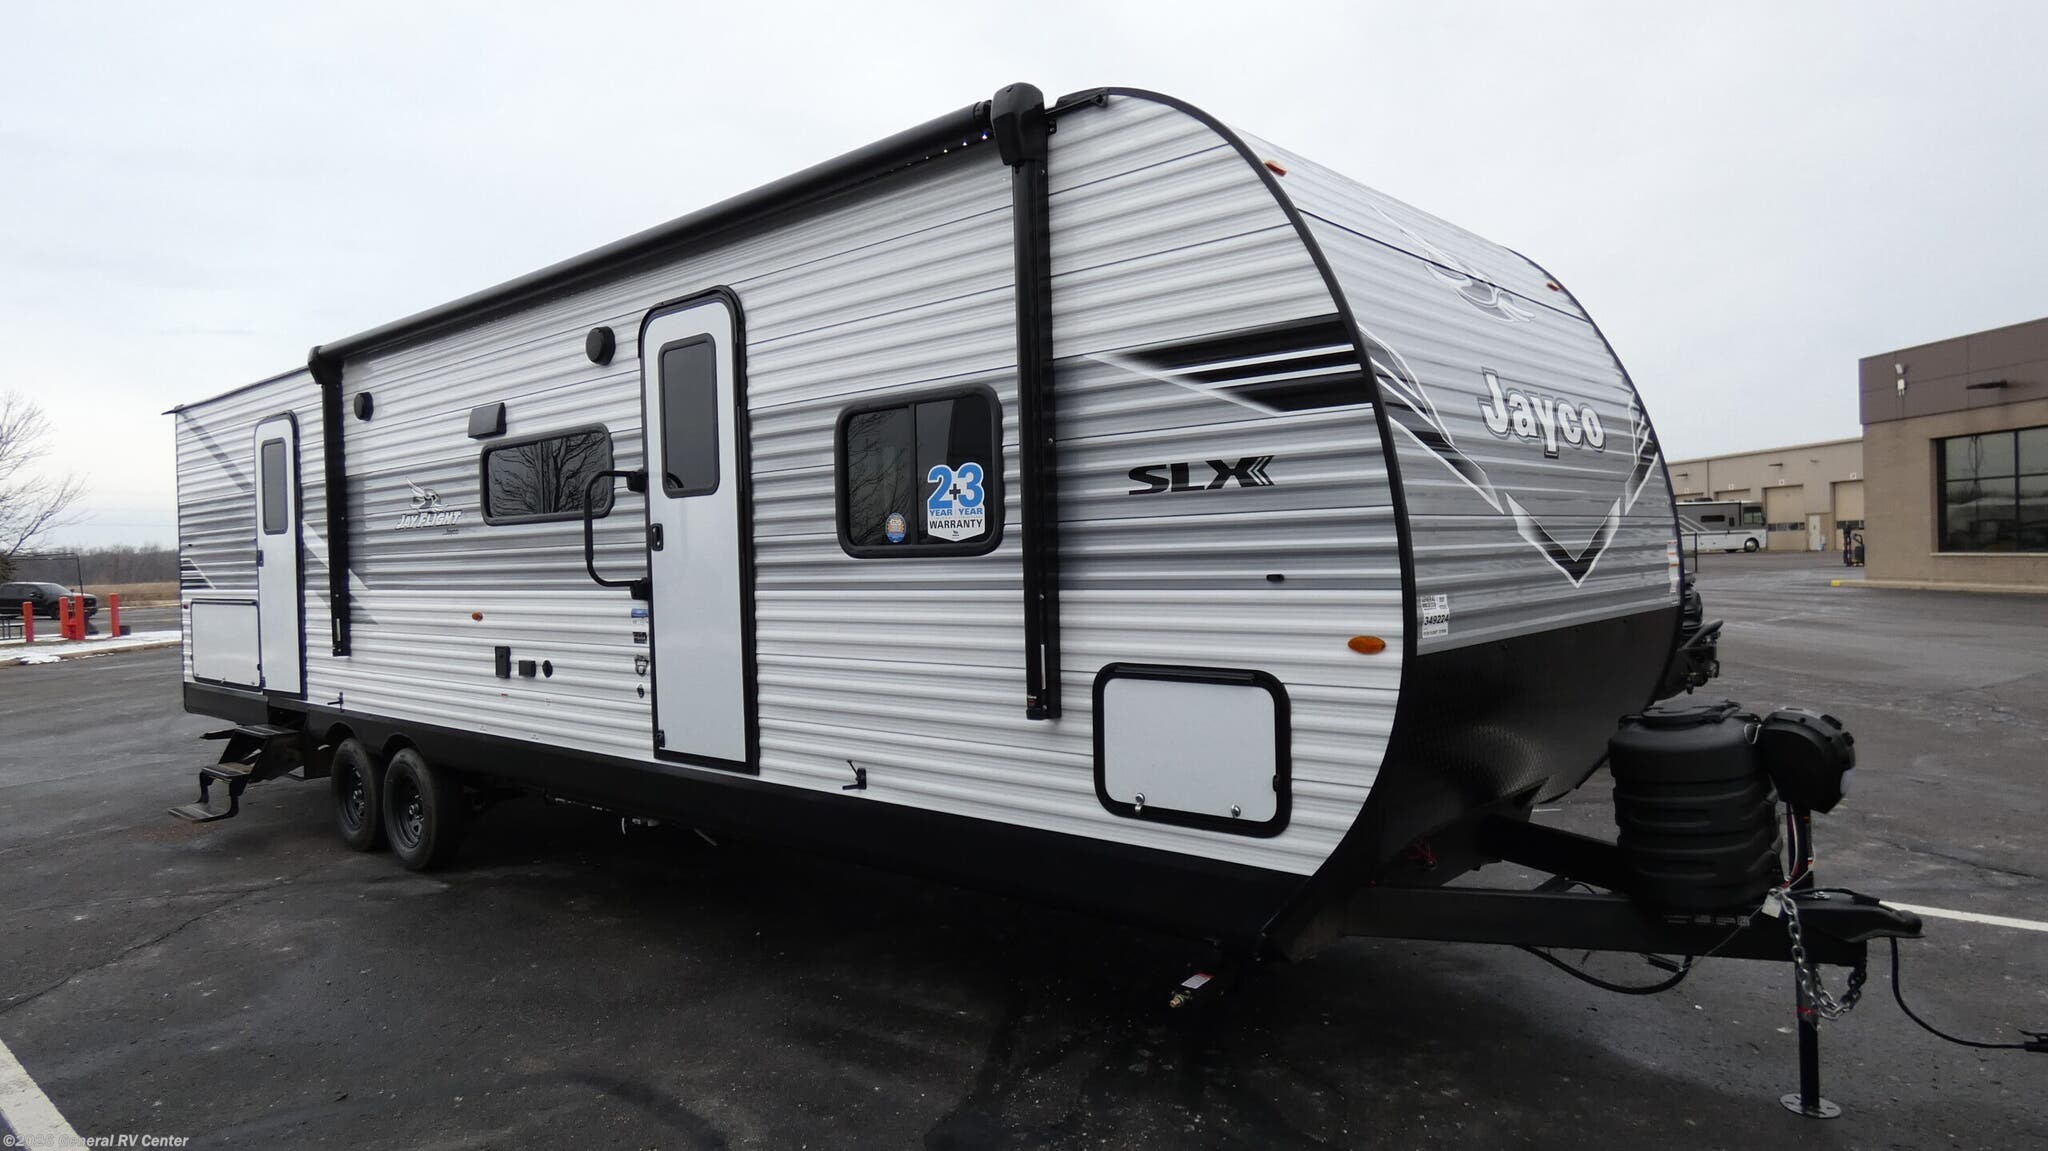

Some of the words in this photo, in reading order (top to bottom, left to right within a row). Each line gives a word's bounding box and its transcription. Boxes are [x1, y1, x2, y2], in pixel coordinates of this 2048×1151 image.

[1478, 367, 1606, 459] Jayco
[1129, 455, 1275, 495] SLX
[397, 513, 419, 530] JAY
[419, 510, 462, 528] FLIGHT
[959, 507, 983, 515] YEAR
[929, 519, 983, 529] WARRANTY
